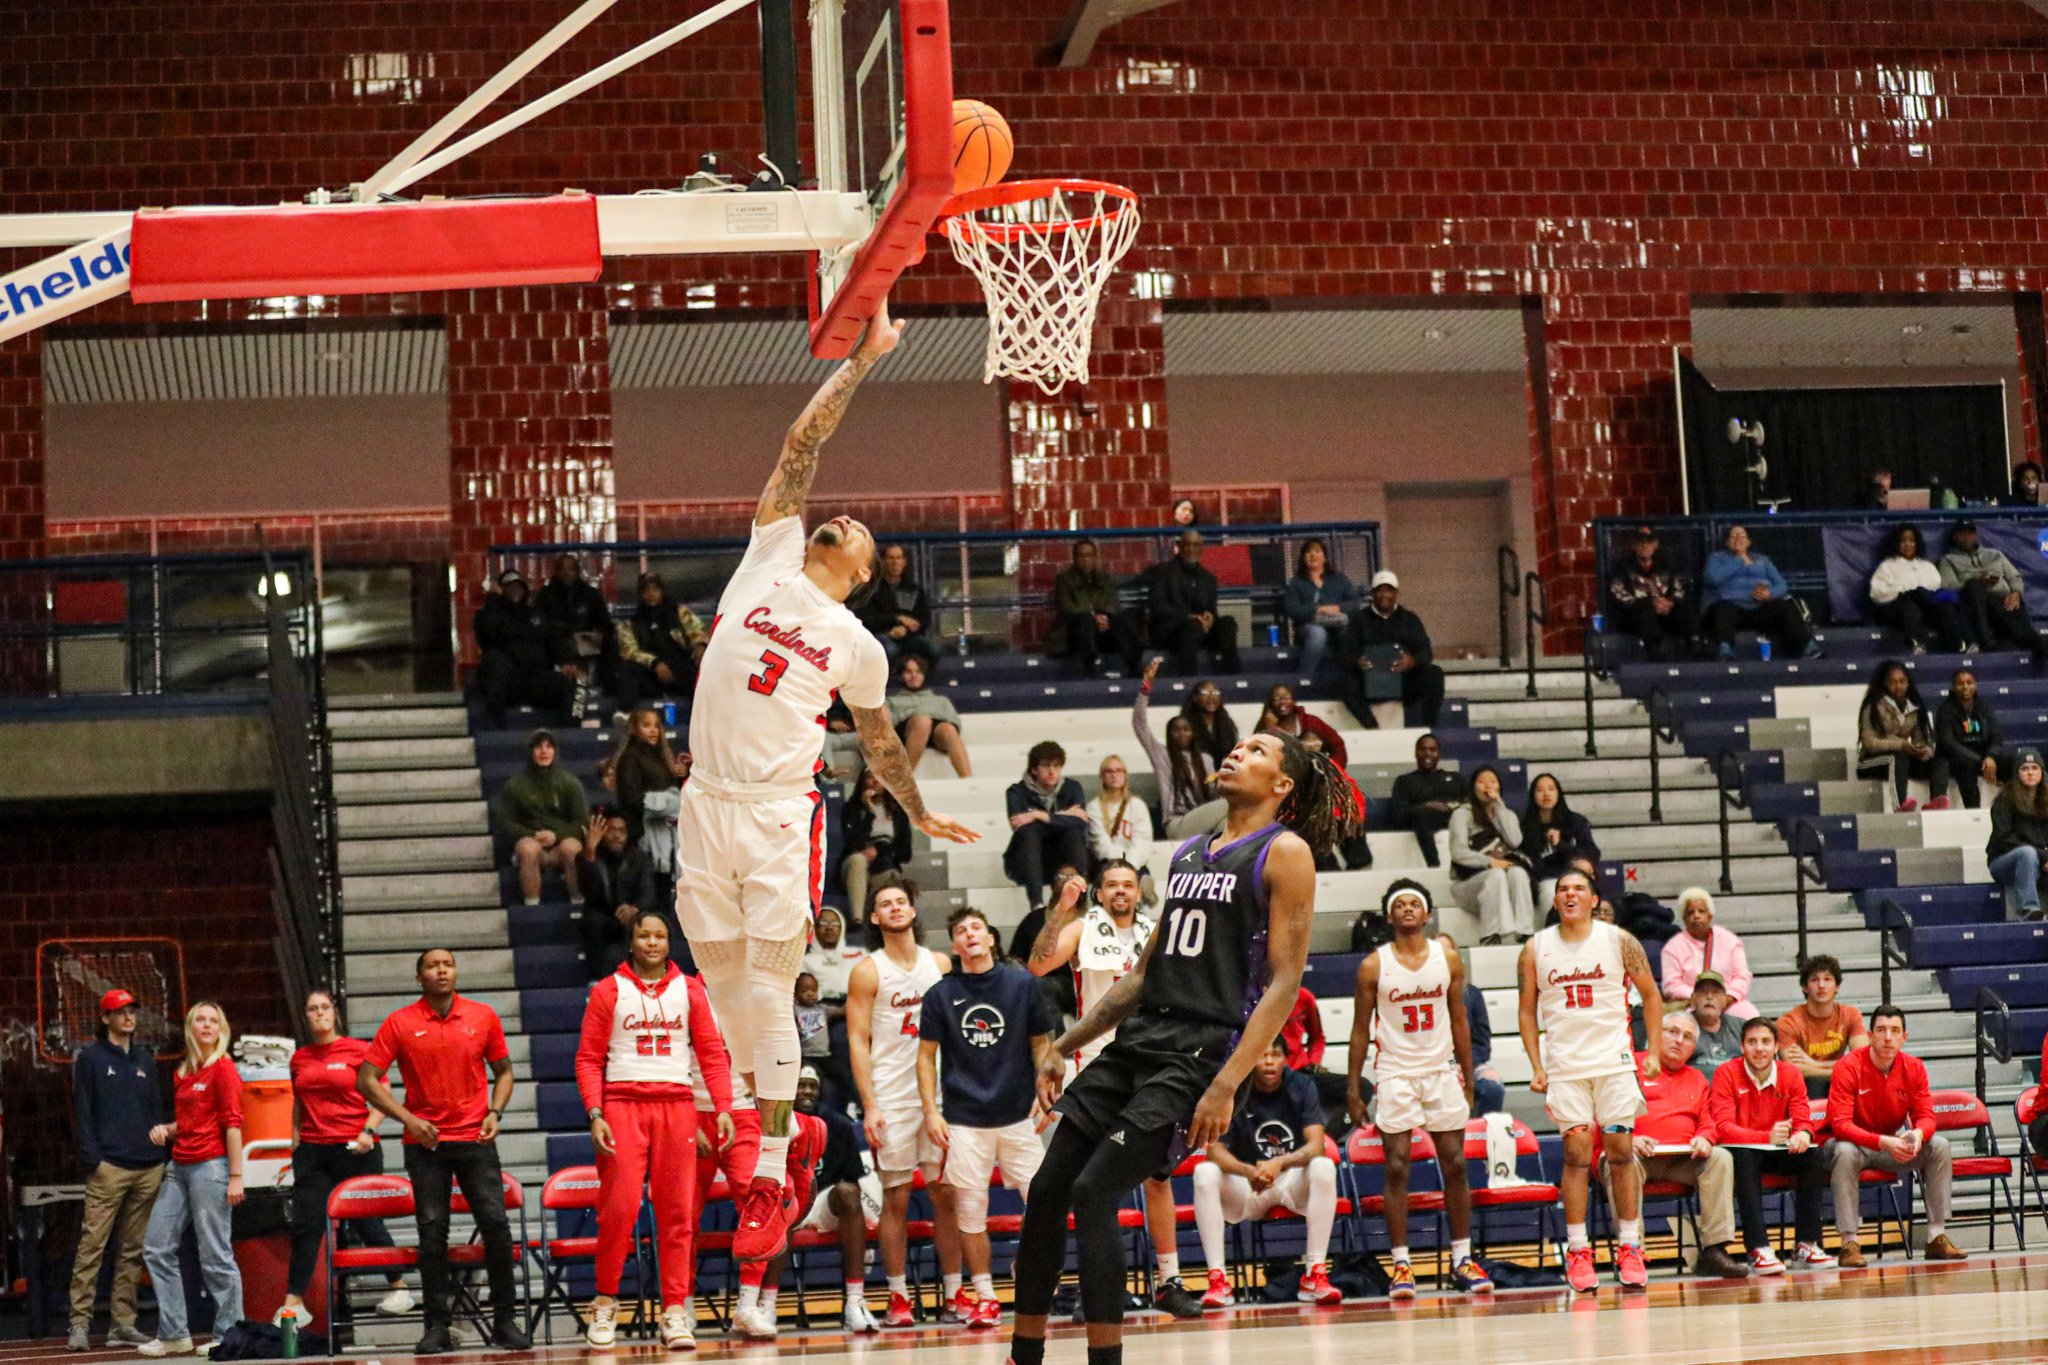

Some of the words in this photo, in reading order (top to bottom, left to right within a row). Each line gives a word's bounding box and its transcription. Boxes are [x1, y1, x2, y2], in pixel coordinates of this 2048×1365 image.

[743, 606, 832, 672] Cardinals
[747, 648, 789, 697] 3
[1165, 871, 1238, 904] KUYPER
[1165, 907, 1207, 958] 10
[1547, 963, 1606, 986] Cardinals
[1388, 983, 1444, 1004] Cardinals
[1563, 984, 1594, 1010] 10
[622, 1013, 684, 1031] Cardinals
[900, 1011, 919, 1039] 4
[1401, 1003, 1435, 1034] 33
[635, 1035, 671, 1057] 22
